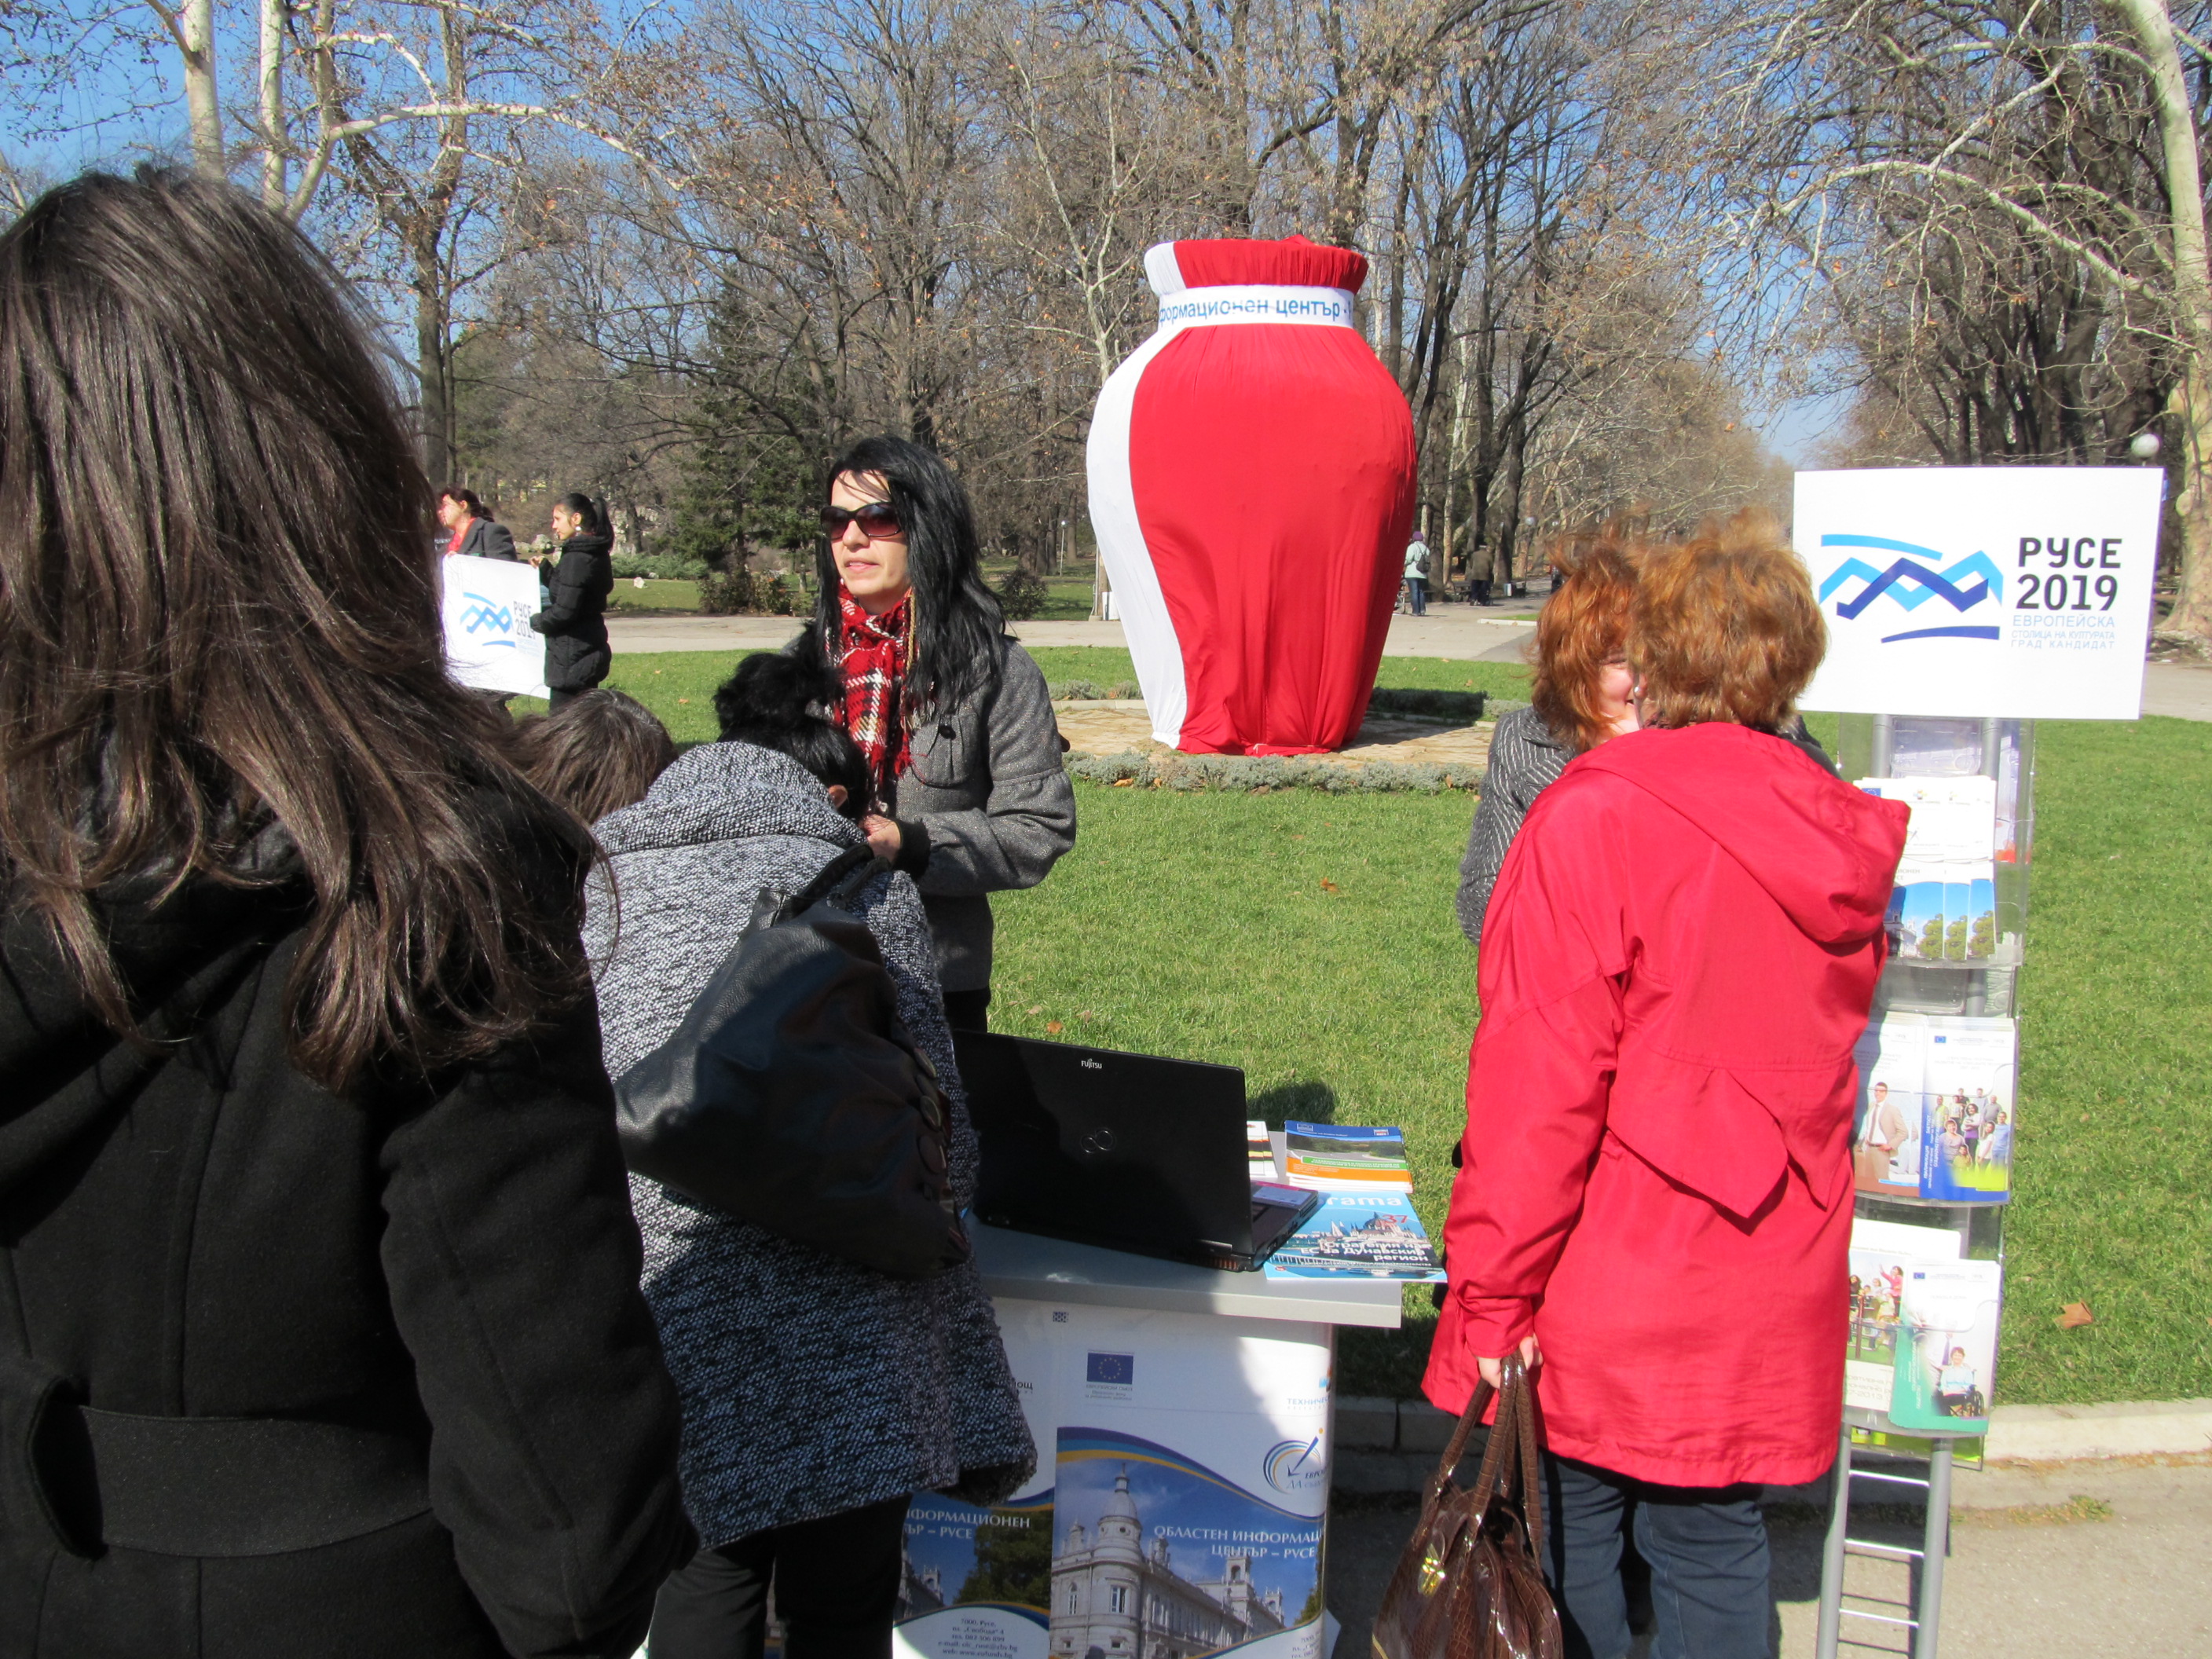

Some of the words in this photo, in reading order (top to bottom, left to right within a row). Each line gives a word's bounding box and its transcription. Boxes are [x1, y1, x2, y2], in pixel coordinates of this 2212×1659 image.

[1276, 299, 1340, 322] център
[2018, 537, 2122, 568] РУСЕ
[2016, 573, 2118, 611] 2019
[2012, 613, 2115, 628] ЕВРОПЕЙСКА
[2011, 630, 2052, 639] СТОЛИЦА
[2069, 631, 2115, 639] КУЛТУРАТА
[2011, 639, 2042, 649] ГРАД
[2049, 640, 2115, 650] КАНДИДАТ
[1081, 1058, 1102, 1069] FUJITSU
[940, 1526, 972, 1540] РУСЕ
[1154, 1525, 1228, 1541] ОБЛАСТЕН
[1284, 1546, 1316, 1558] РУСЕ
